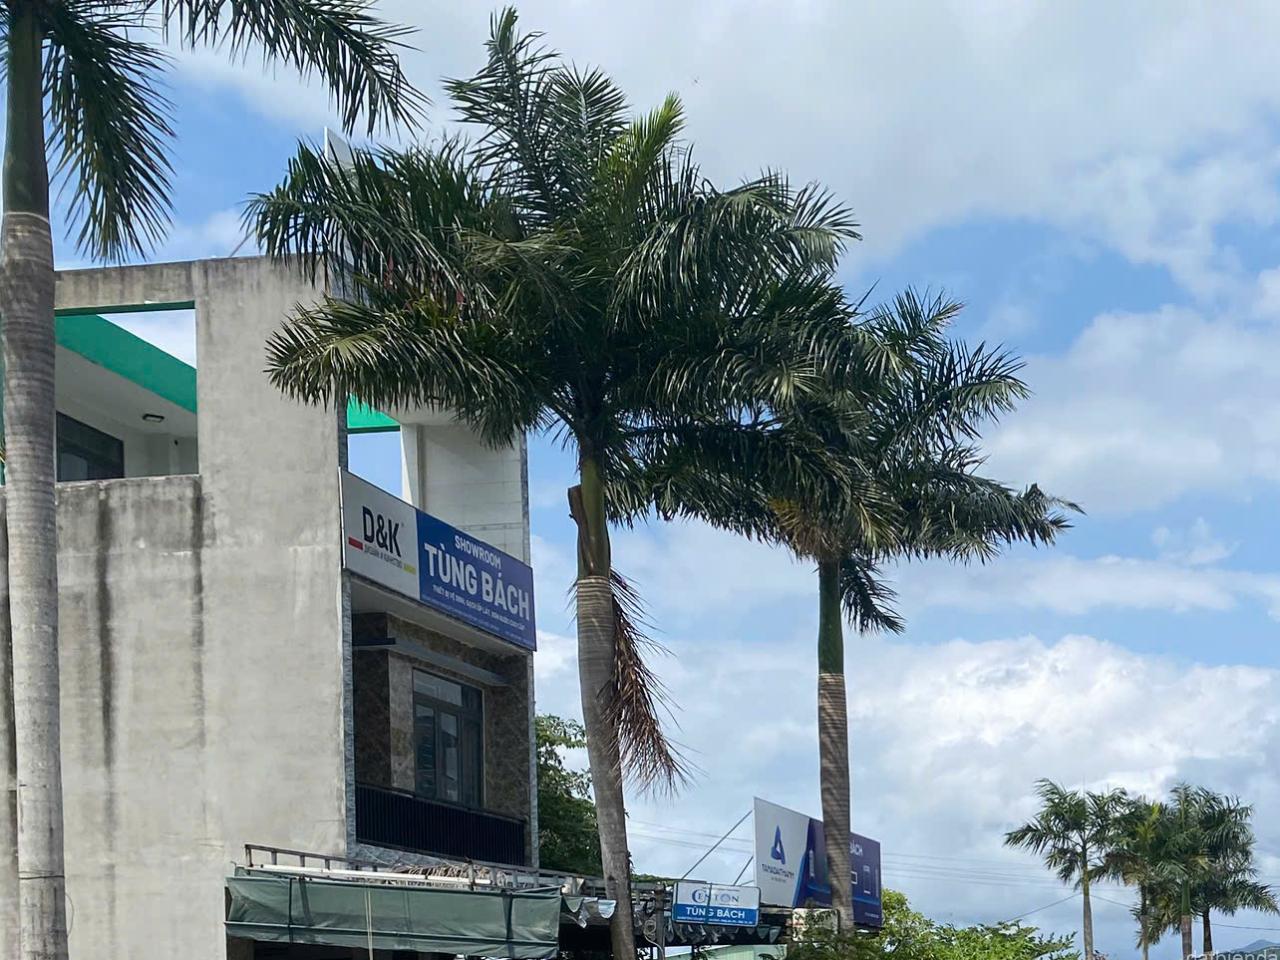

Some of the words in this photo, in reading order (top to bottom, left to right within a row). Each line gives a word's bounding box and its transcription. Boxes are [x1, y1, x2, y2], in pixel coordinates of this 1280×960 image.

[362, 505, 402, 558] D&K
[454, 534, 502, 571] SHOWROOM
[424, 542, 477, 596] TÙNG
[482, 570, 530, 621] BÁCH
[717, 907, 745, 919] BÁCH
